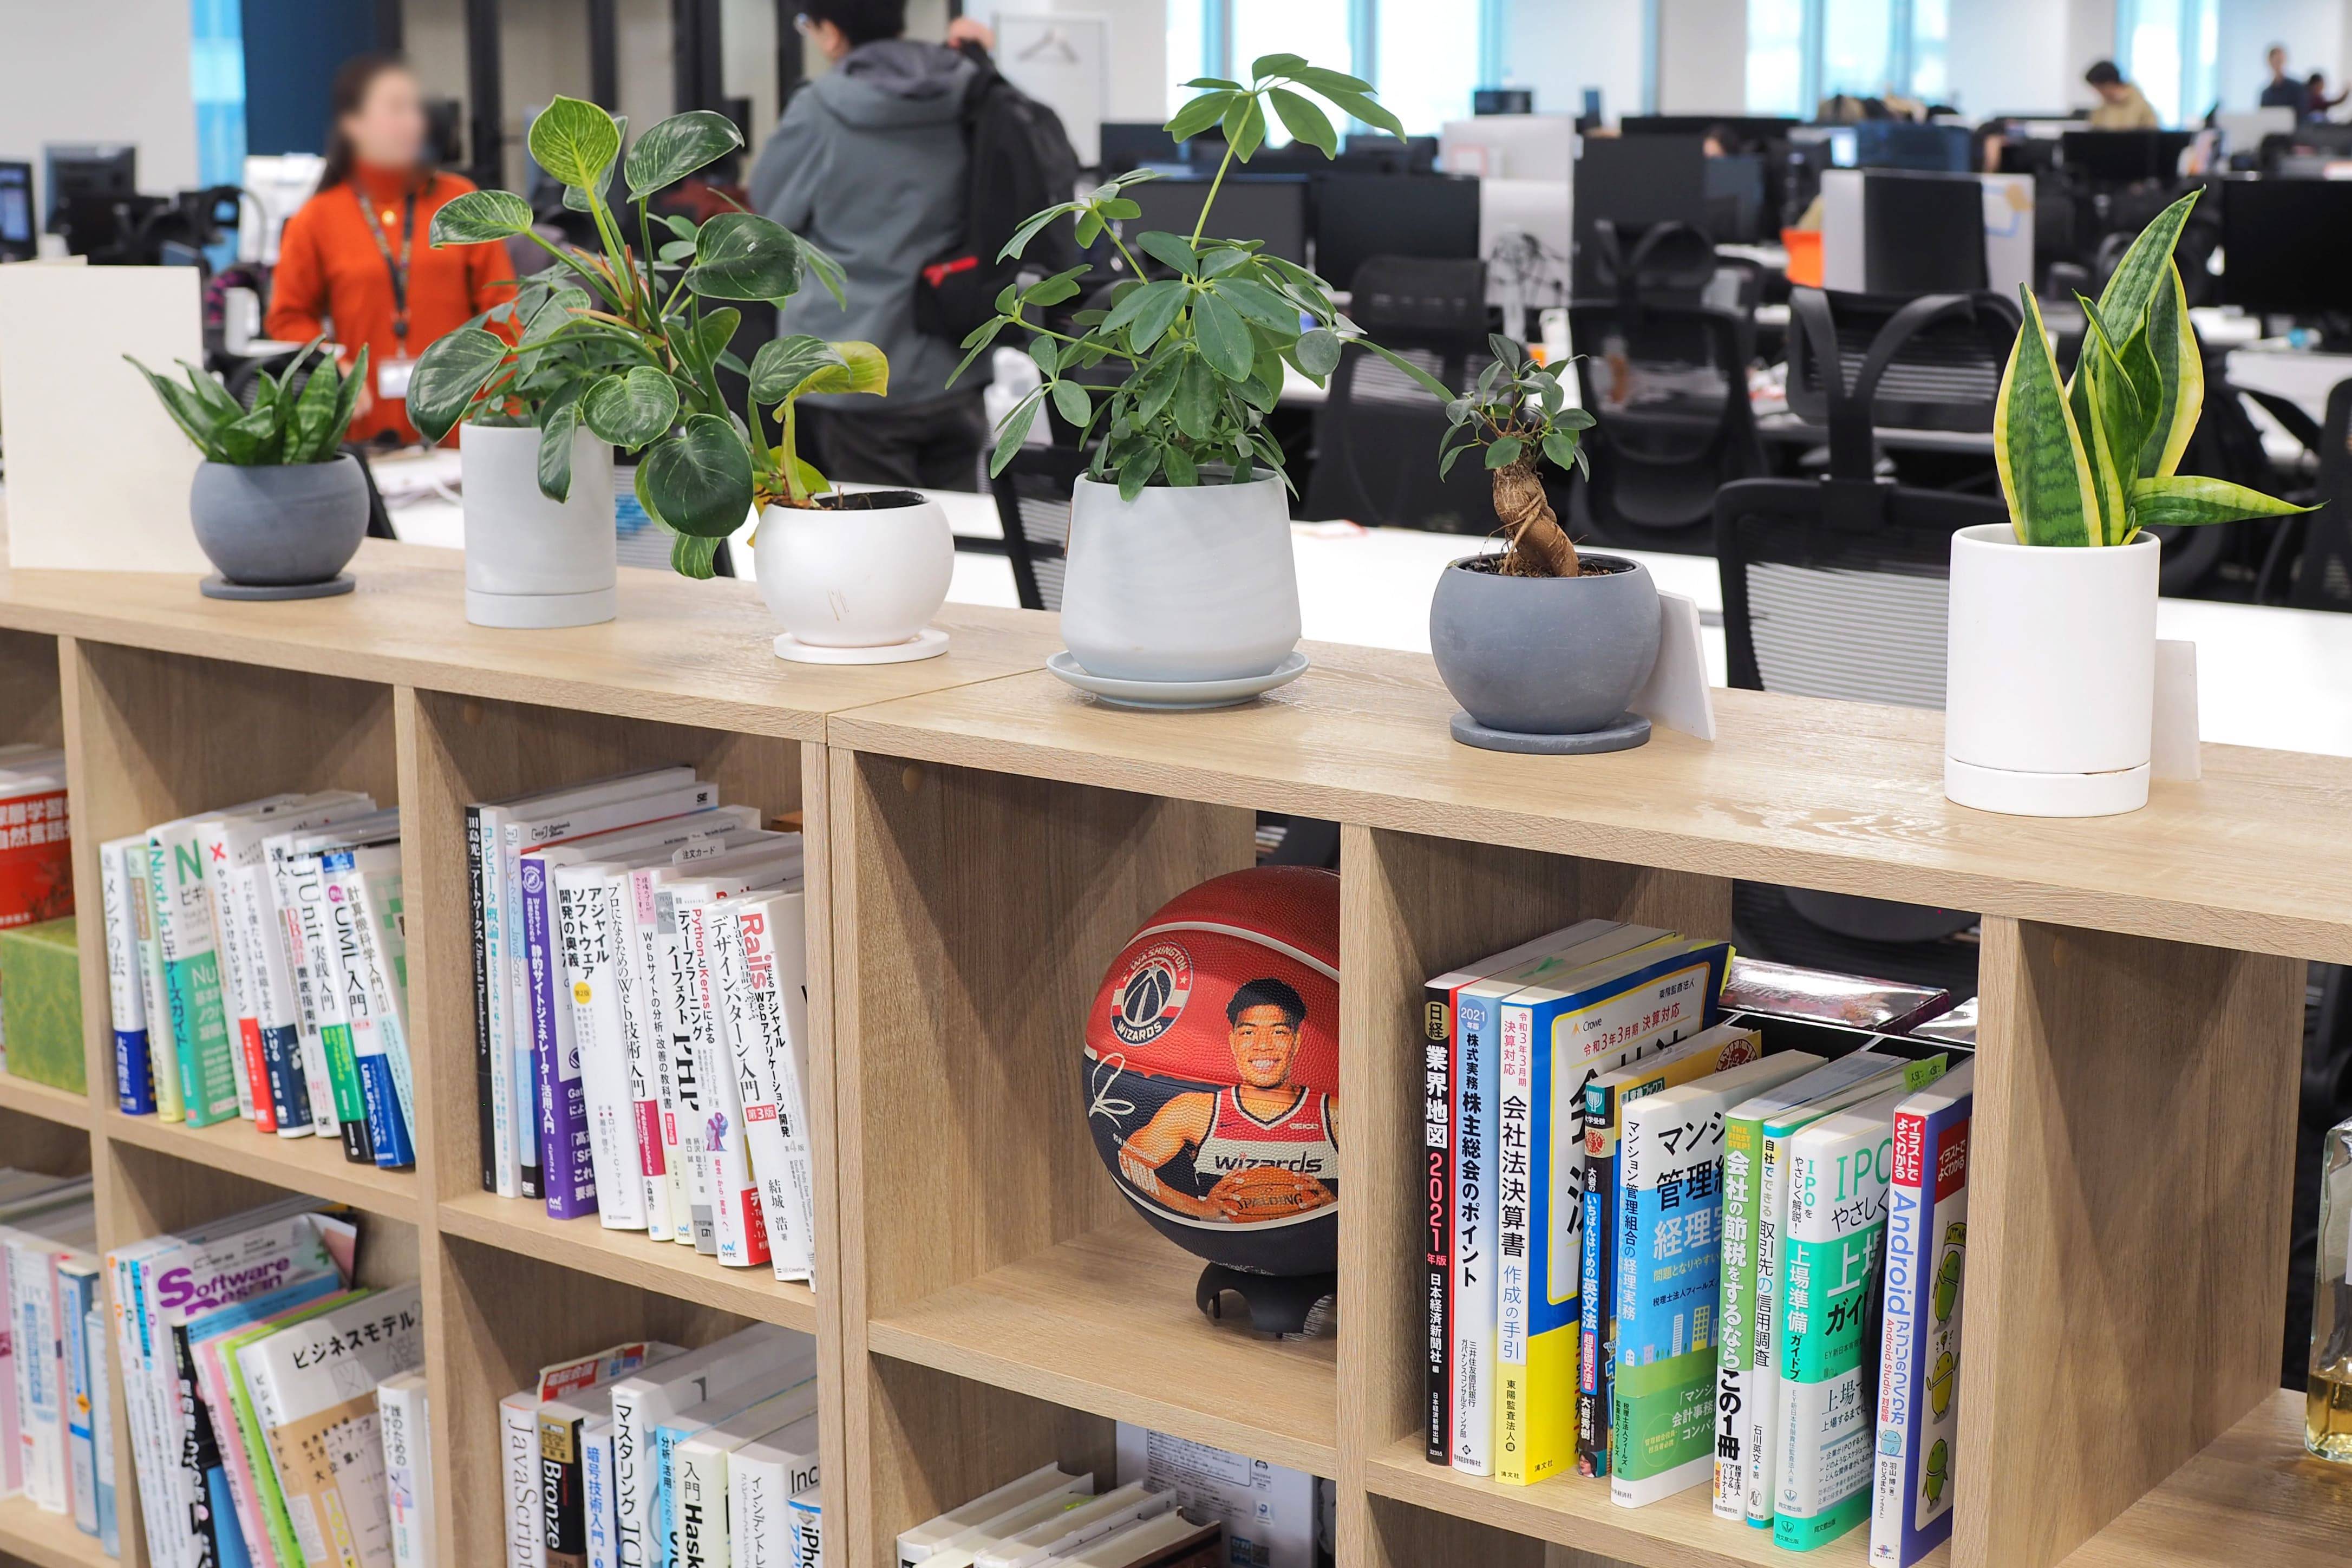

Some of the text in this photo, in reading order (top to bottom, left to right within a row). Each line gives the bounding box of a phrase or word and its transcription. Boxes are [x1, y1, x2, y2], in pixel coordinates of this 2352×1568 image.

[696, 792, 708, 802] SE
[483, 827, 500, 940] コンピュータ概論
[682, 846, 716, 860] 注文カード
[347, 885, 384, 992] 計算機科学入門
[559, 889, 579, 968] 開発の奥義
[573, 889, 594, 980] ソフトウェア
[588, 887, 610, 964] アジャイル
[335, 906, 368, 1018] UML入門
[678, 910, 704, 1041] ディープラーニング
[691, 909, 715, 1044] PythonとKerasによる
[740, 912, 786, 1048] Rails による アジャイル
[1131, 945, 1188, 972] WASHINGTON
[1658, 977, 1695, 1000] 東陽監査法人
[607, 883, 646, 1100] プロになるためのWeb技術入門
[642, 931, 672, 1109] Webサイトの分析・改善の教科書
[710, 914, 760, 1103] デザインパターン入門
[1428, 1003, 1444, 1039] 日経
[1460, 1006, 1486, 1021] 2021
[1117, 1020, 1162, 1042] WIZARDS
[1466, 1022, 1480, 1030] 年版
[1504, 1021, 1516, 1076] 決算対応
[1518, 1011, 1527, 1087] 令和3年3月期
[1583, 1017, 1603, 1032] Crowe
[1583, 1002, 1681, 1057] 令和3年3月期 決算対応
[755, 991, 791, 1138] Webアプリケーション開発
[747, 1106, 775, 1121] 第3版
[1425, 1044, 1448, 1149] 業界地図
[1728, 1132, 1751, 1141] FIRST
[1728, 1139, 1750, 1150] STEP!
[1730, 1125, 1748, 1134] THE
[1894, 1118, 1909, 1179] よくわかる
[1906, 1120, 1922, 1182] イラストで
[1939, 1139, 1966, 1165] イラストで
[1214, 1151, 1325, 1175] wizards
[1461, 1033, 1482, 1288] 株式実務 株主総会のポイント
[1587, 1166, 1597, 1192] 大岩の
[1804, 1160, 1815, 1219] IPOを
[1938, 1155, 1965, 1182] よくわかる
[768, 1178, 785, 1210] 結城
[1238, 1193, 1304, 1211] SPALDING
[1429, 1152, 1443, 1252] 2021
[1622, 1121, 1641, 1321] マンション管理組合の経理実務
[1792, 1156, 1804, 1234] やさしく解説!
[1831, 1188, 1889, 1233] やさしく
[1501, 1094, 1527, 1360] 会社法決算書 作成の手引
[1755, 1139, 1776, 1368] 自社でできる 取引先の信用調査
[158, 1257, 290, 1308] Software
[1582, 1194, 1598, 1331] いちばんはじめの英文法
[1652, 1278, 1716, 1308] 税理士法人フィールズ
[1429, 1273, 1442, 1363] 日本経済新聞社
[1717, 1151, 1750, 1461] 会社の節税をするならこの1冊
[1788, 1244, 1811, 1383] 上場準備 ガイドブ
[1888, 1190, 1918, 1426] Android アプリのつくり方
[292, 1310, 415, 1370] ビジネスモデル
[1885, 1318, 1895, 1360] Android
[1459, 1338, 1468, 1439] ガバナンスコンサルティング部
[1468, 1341, 1477, 1408] 三井住友信託銀行
[1882, 1361, 1894, 1397] Studio
[1506, 1380, 1517, 1441] 東陽監査法人
[1580, 1396, 1592, 1440] 大岩秀樹
[1622, 1402, 1630, 1466] 税理士法人フィールズ
[616, 1404, 637, 1515] マスタリング
[1534, 1460, 1554, 1473] 清文社
[1752, 1424, 1763, 1464] 石川英文
[508, 1419, 540, 1568] JavaScript
[543, 1460, 563, 1549] Bronze
[586, 1446, 605, 1547] 暗号技術入門
[790, 1465, 819, 1494] Inc
[1500, 1470, 1520, 1480] 清文社
